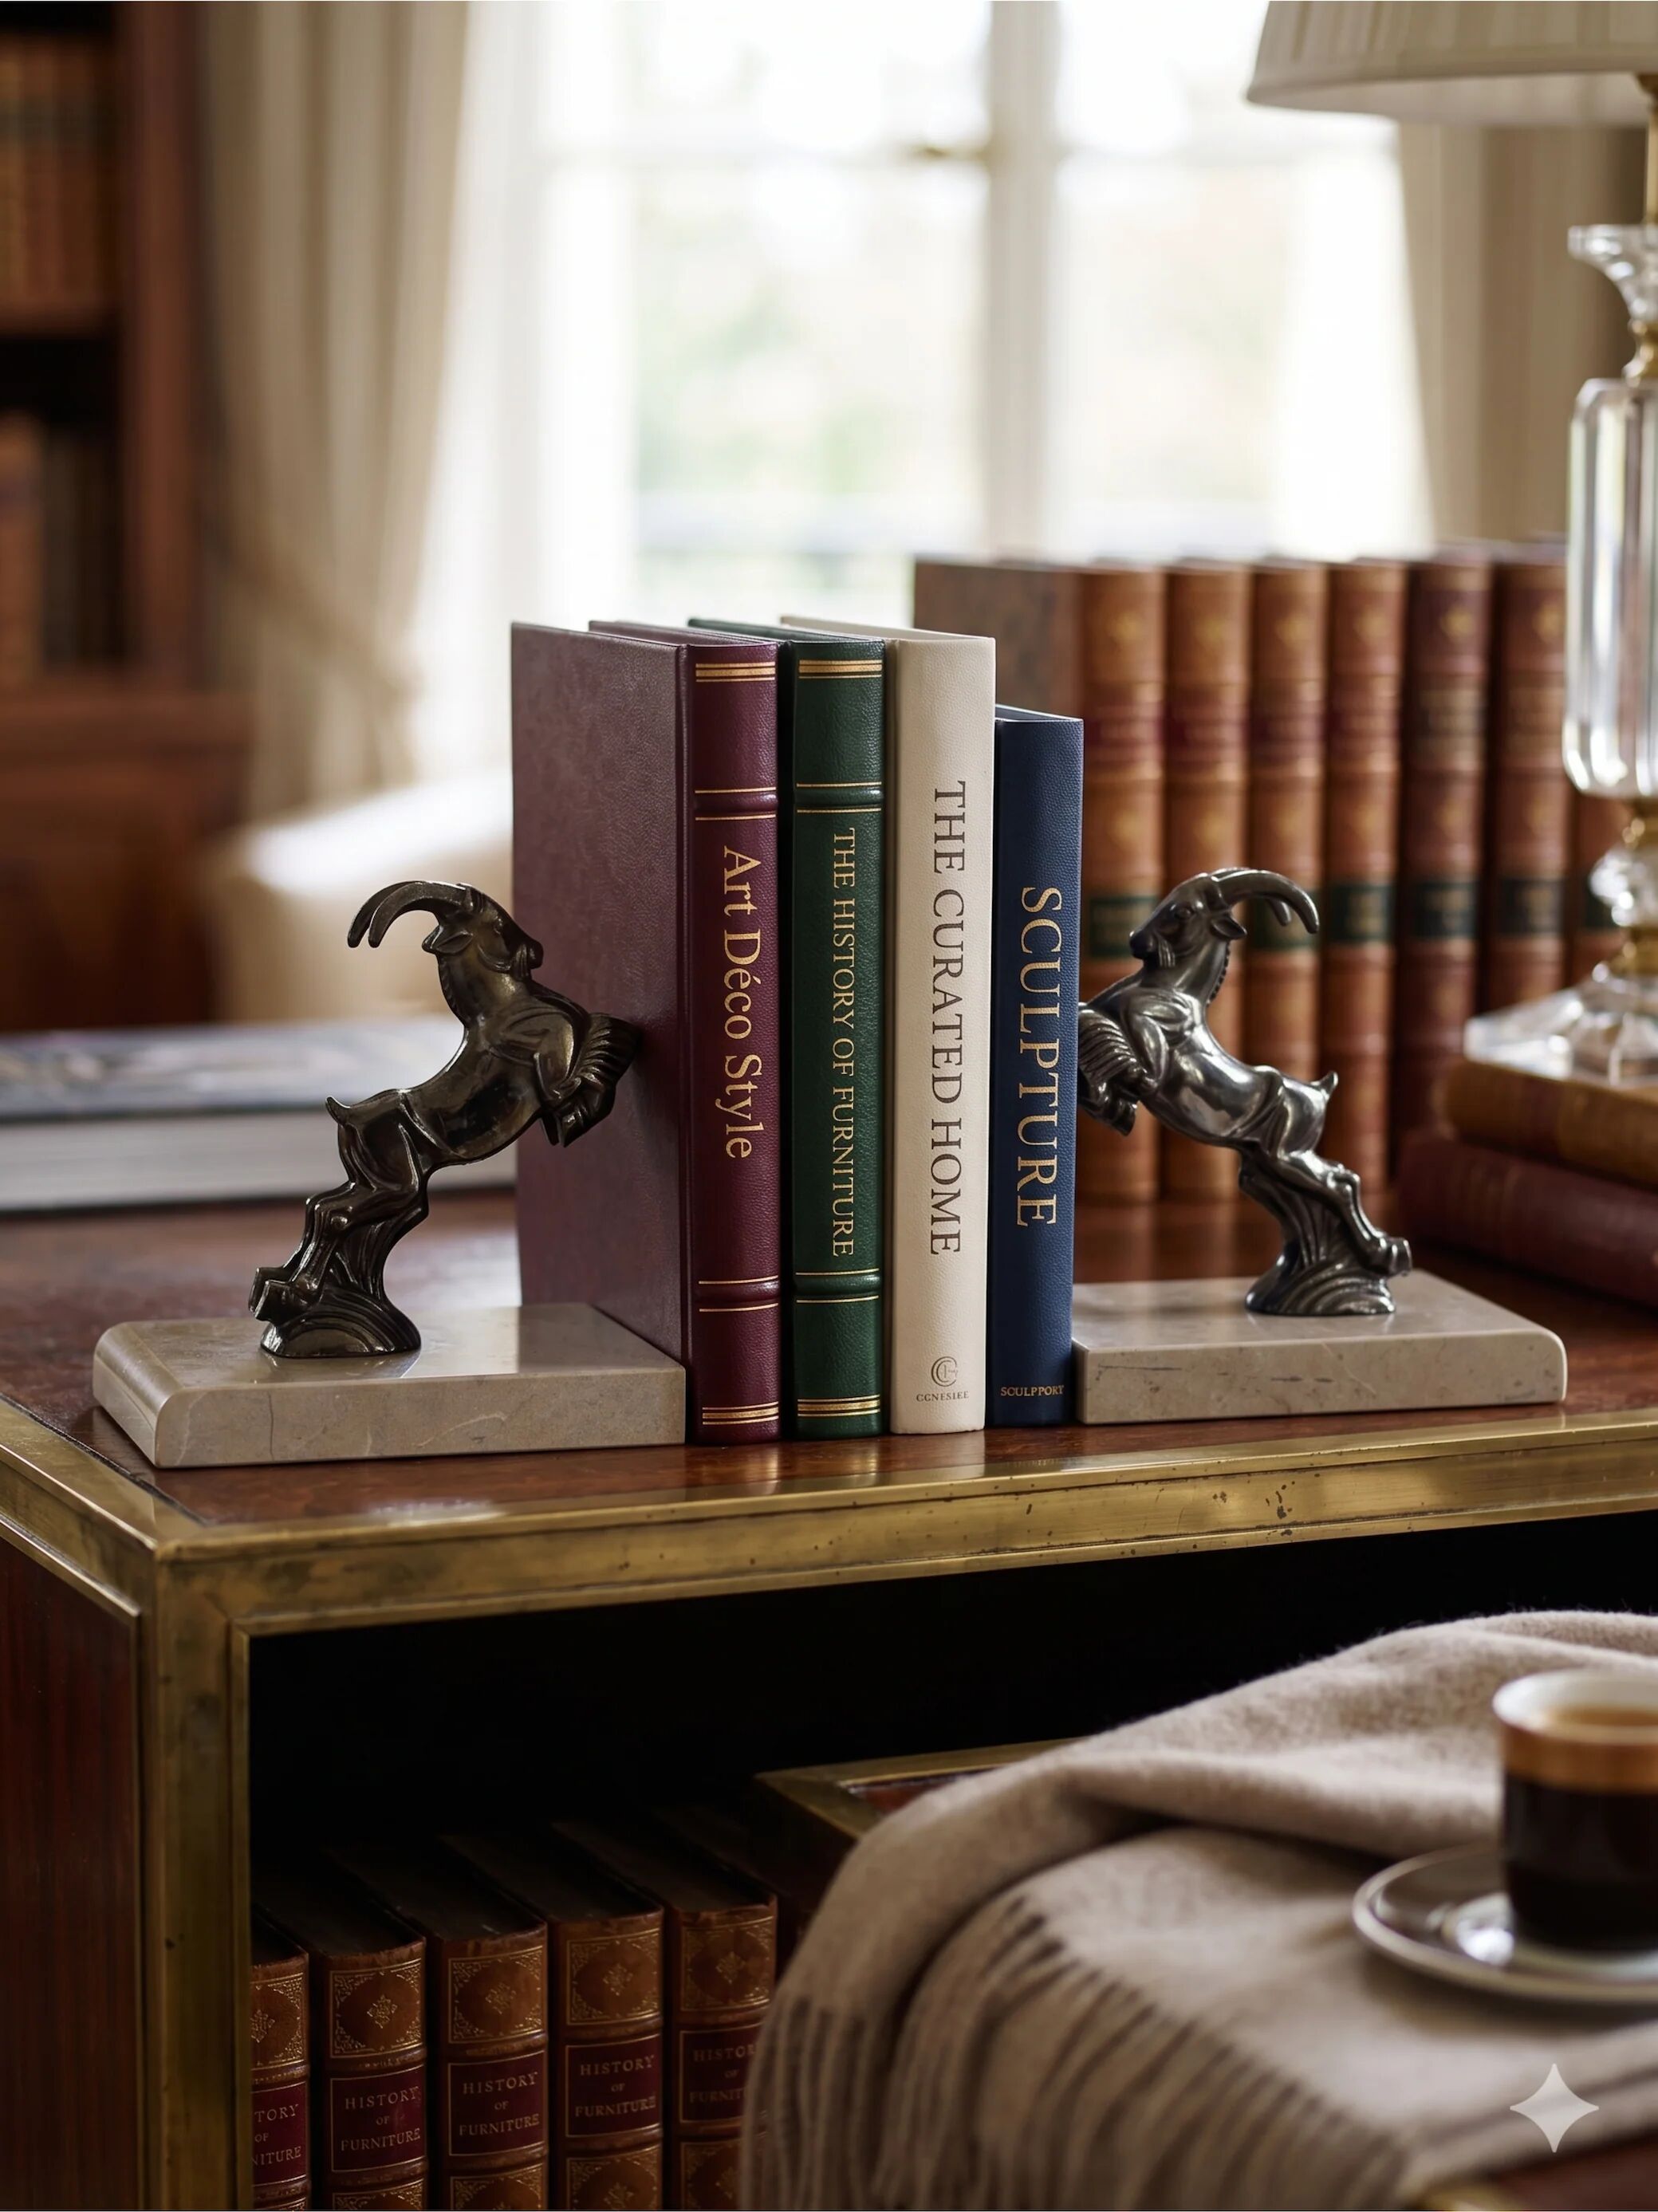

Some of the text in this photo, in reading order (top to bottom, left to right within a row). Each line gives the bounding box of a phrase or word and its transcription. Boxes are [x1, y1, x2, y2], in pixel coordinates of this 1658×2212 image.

[715, 845, 764, 1158] Art Déco Style
[930, 780, 966, 1254] THE CURATED HOME
[832, 828, 856, 1257] THE HISTORY OF FURNITURE
[1016, 886, 1063, 1226] SCULPTURE
[580, 2054, 655, 2076] HISTORY
[462, 2071, 538, 2095] HISTORY
[610, 2082, 626, 2092] OF
[345, 2085, 419, 2110] HISTORY
[494, 2100, 510, 2111] OF
[574, 2096, 656, 2118] FURNITURE
[254, 2103, 300, 2123] TORY
[375, 2115, 390, 2126] OF
[459, 2113, 540, 2136] FURNITURE
[254, 2131, 270, 2143] OF
[340, 2127, 421, 2151] FURNITURE
